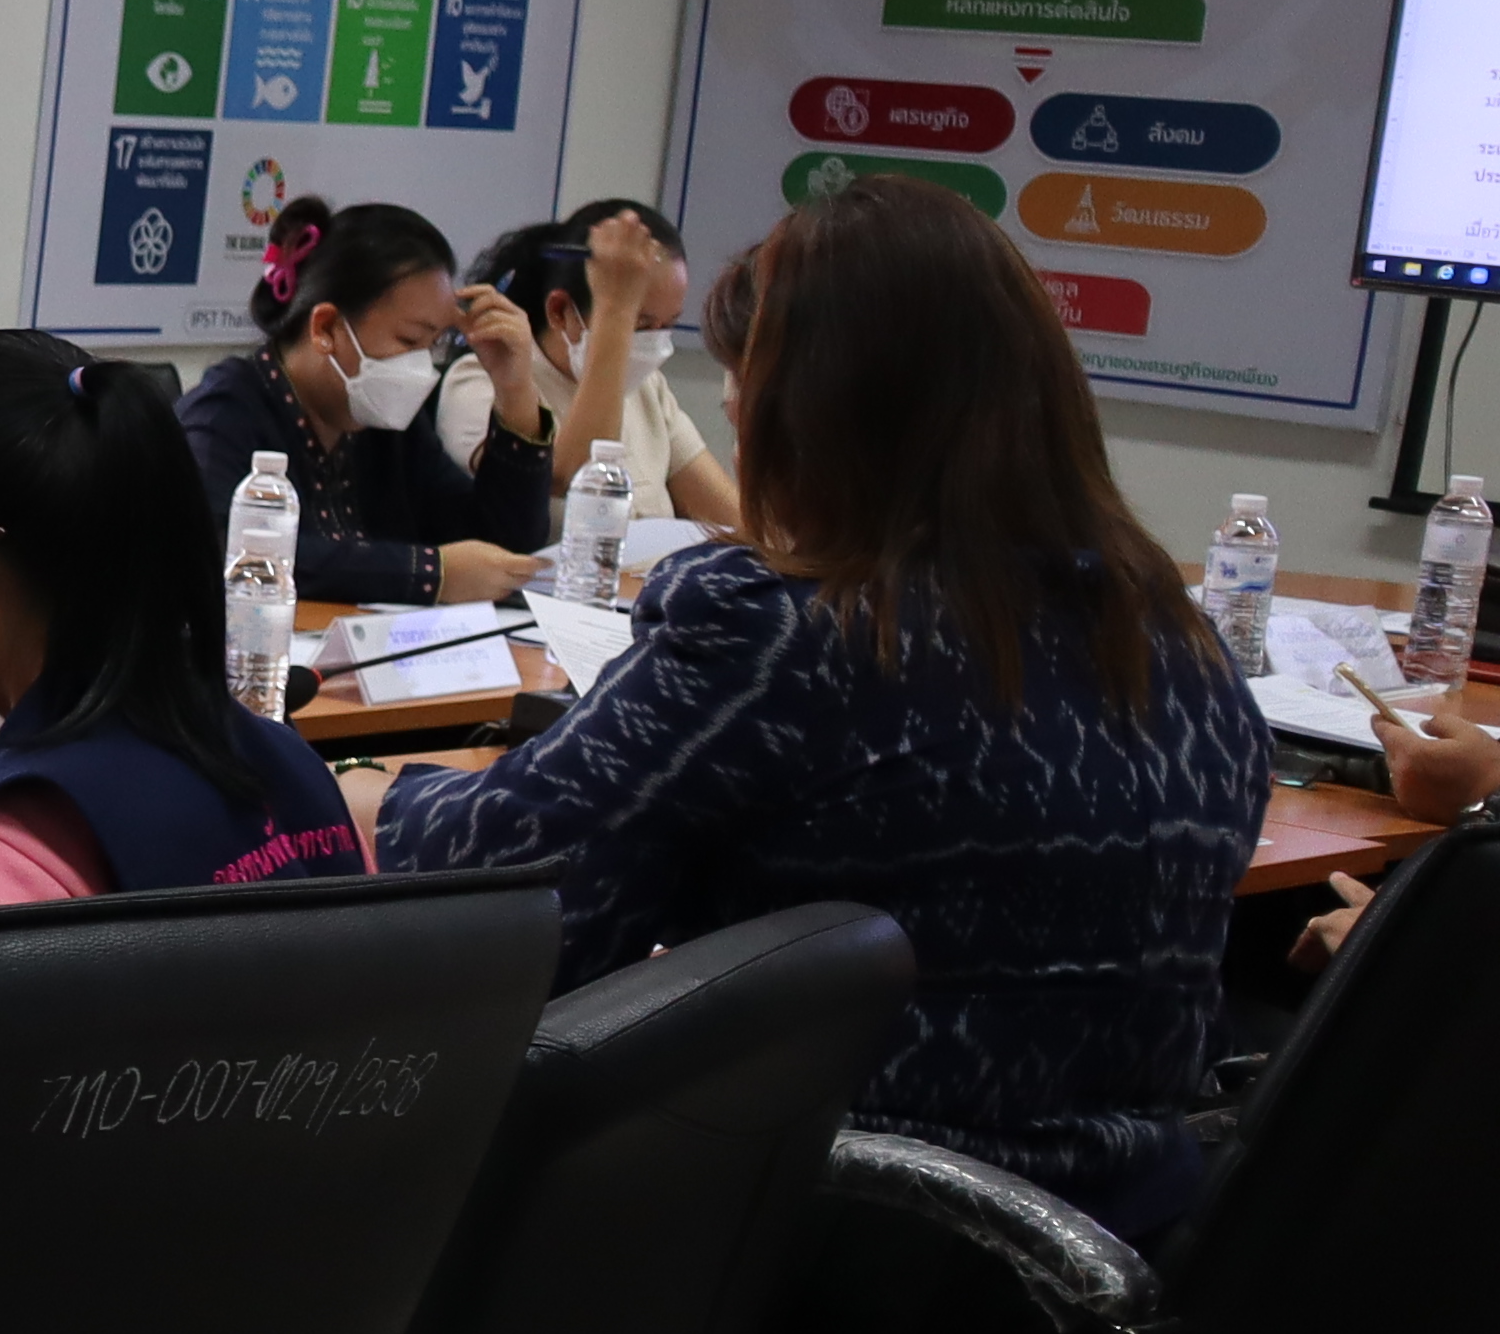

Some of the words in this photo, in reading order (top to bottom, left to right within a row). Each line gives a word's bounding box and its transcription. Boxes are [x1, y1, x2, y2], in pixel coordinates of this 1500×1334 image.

[889, 106, 970, 131] เศรษฐกิจ
[1147, 121, 1206, 146] สังคม
[114, 134, 136, 170] 17
[1110, 202, 1212, 231] วัฒนธรรม
